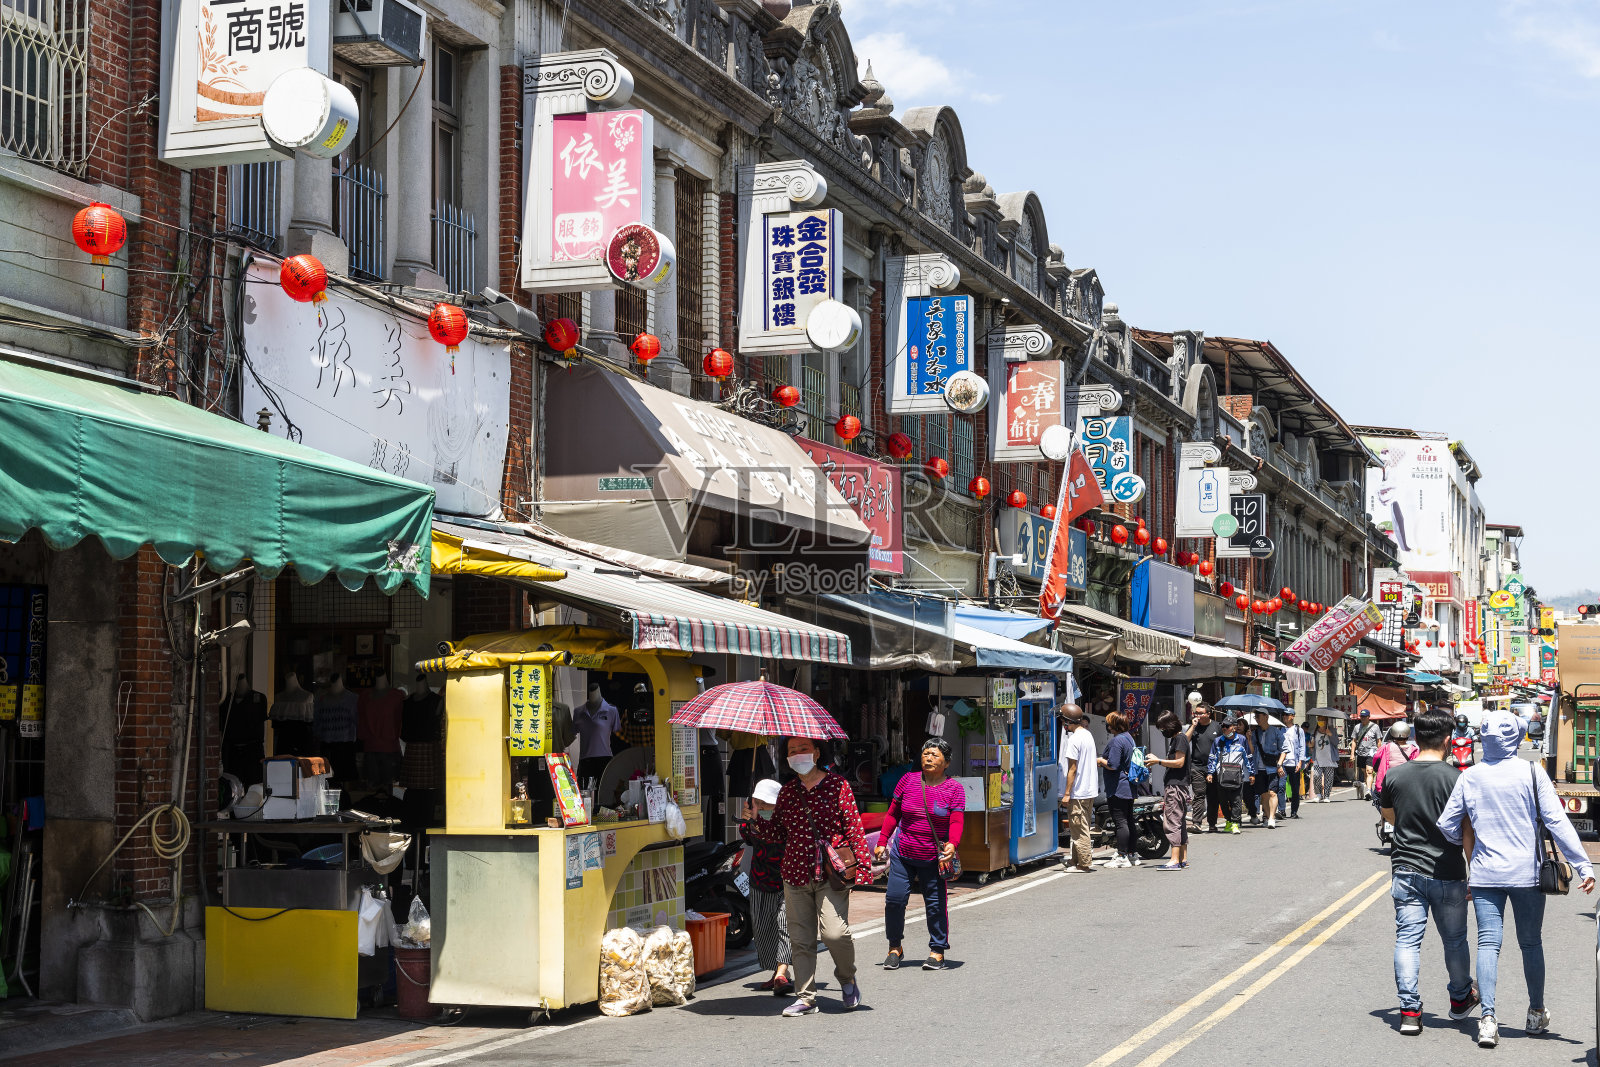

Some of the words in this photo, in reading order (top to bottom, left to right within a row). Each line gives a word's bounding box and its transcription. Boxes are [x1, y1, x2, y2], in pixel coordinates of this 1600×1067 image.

[227, 2, 305, 56] 商號
[559, 133, 639, 209] 依美
[558, 218, 600, 238] 服飾
[797, 215, 828, 294] 金合發
[772, 225, 796, 327] 珠寶銀樓
[1010, 419, 1039, 439] 布行
[1113, 441, 1125, 468] 鞋坊
[1234, 499, 1258, 516] HO
[1380, 583, 1402, 593] 老街
[1384, 593, 1398, 601] 101
[512, 668, 525, 751] 金桔甘蔗汁
[528, 668, 542, 750] 檸檬甘蔗汁
